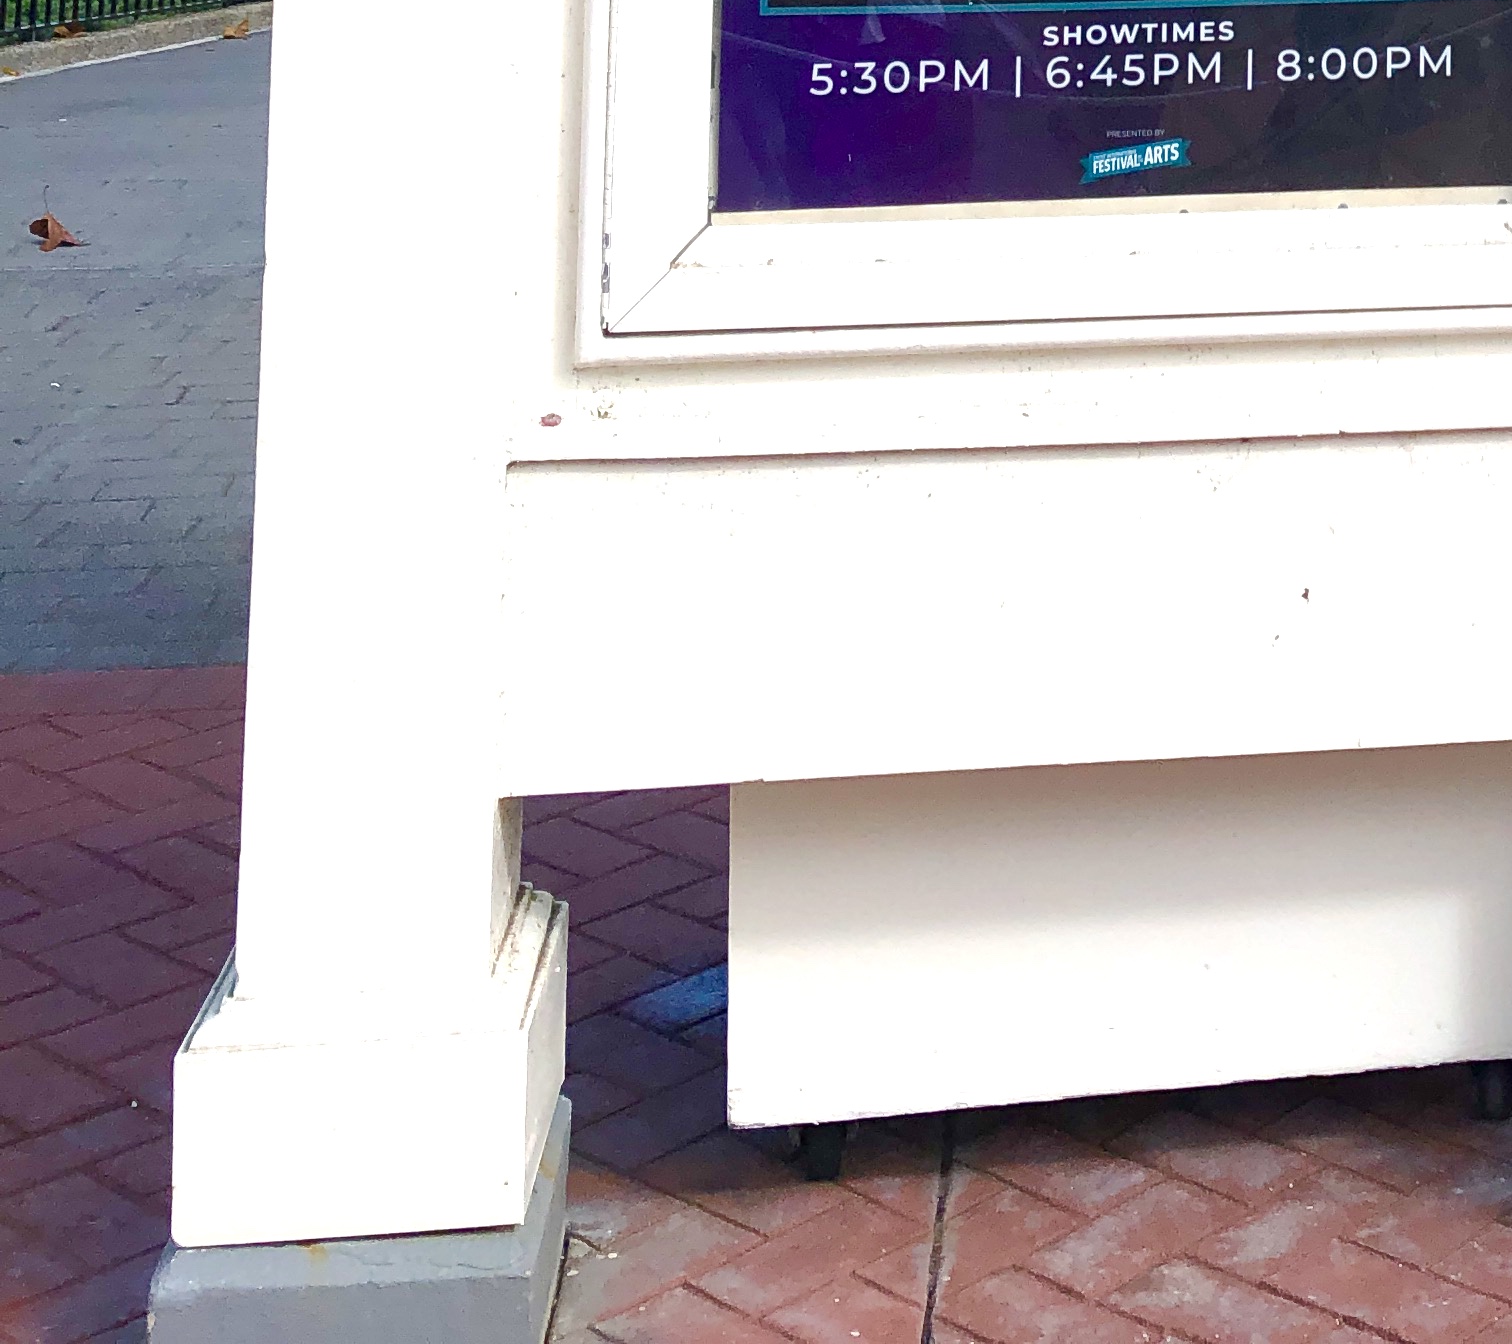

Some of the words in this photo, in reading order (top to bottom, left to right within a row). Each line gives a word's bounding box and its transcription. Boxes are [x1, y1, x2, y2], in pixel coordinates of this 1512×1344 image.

[1042, 20, 1235, 46] SHOWTIMES
[809, 59, 989, 95] 5:30PM
[1046, 51, 1222, 89] 6:45PM
[1277, 45, 1451, 82] 8:00PM
[1106, 130, 1153, 138] PRESENTED
[1093, 153, 1140, 174] FESTIVAL
[1144, 143, 1179, 165] ARTS
